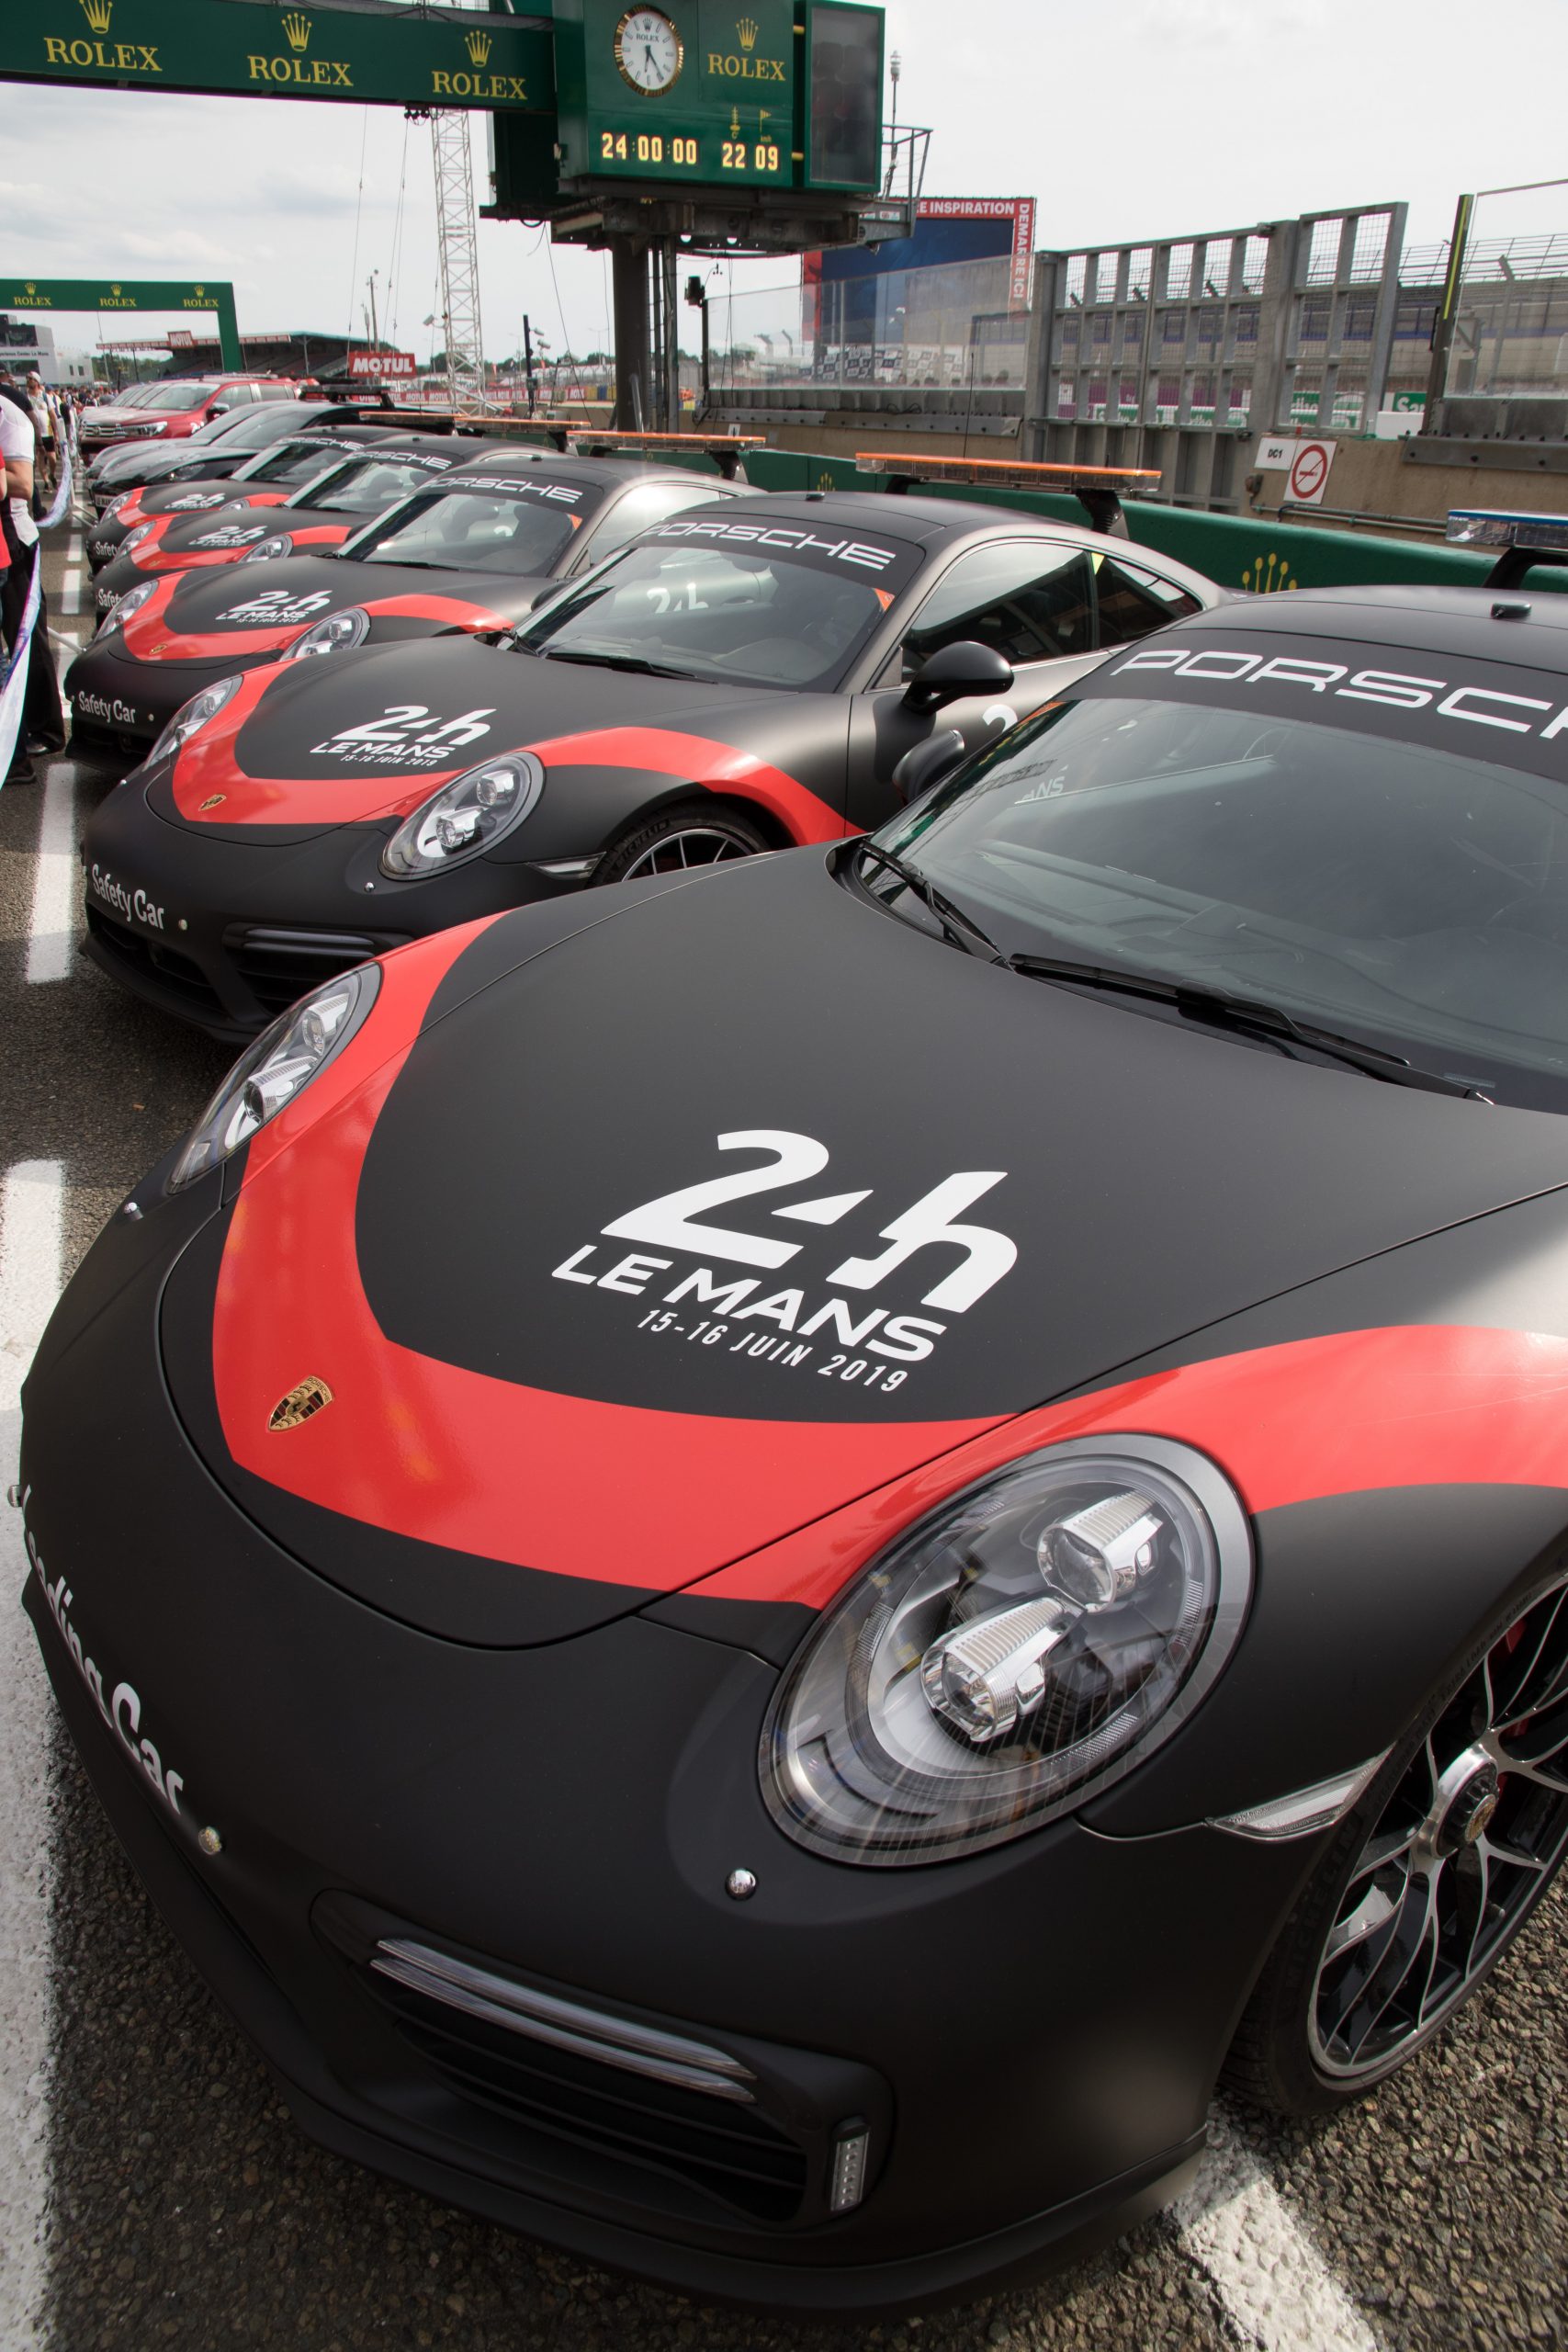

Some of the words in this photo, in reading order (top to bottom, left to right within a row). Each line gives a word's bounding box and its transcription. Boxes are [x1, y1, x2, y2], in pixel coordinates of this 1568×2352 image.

[636, 33, 660, 43] ROLEX
[44, 37, 163, 72] ROLEX
[707, 53, 786, 82] ROLEX
[248, 55, 354, 86] ROLEX
[432, 71, 528, 100] ROLEX
[722, 141, 746, 169] 22
[755, 144, 778, 172] 09
[930, 201, 1015, 214] INSPIRATION
[1015, 203, 1030, 276] DEMARRE
[14, 296, 52, 306] ROLEX
[99, 298, 137, 307] ROLEX
[1013, 278, 1025, 299] ICI
[184, 299, 219, 308] ROLEX
[170, 334, 193, 346] MOTUL
[353, 357, 413, 373] MOTUL
[1268, 448, 1283, 458] DC1
[643, 522, 897, 571] PORSCHE
[215, 612, 246, 620] LE
[243, 611, 310, 619] MANS
[78, 690, 111, 723] Safety
[113, 699, 136, 724] Car
[310, 742, 358, 753] LE
[352, 742, 456, 759] MANS
[340, 754, 371, 763] 15-16
[374, 755, 405, 764] JUIN
[405, 757, 438, 766] 2019
[92, 864, 131, 922] Safety
[134, 889, 164, 930] Car
[551, 1244, 673, 1295] LE
[662, 1267, 947, 1362] MANS
[637, 1308, 728, 1346] 15-16
[729, 1331, 813, 1367] JUIN
[818, 1354, 908, 1393] 2019
[111, 1682, 184, 1815] Car
